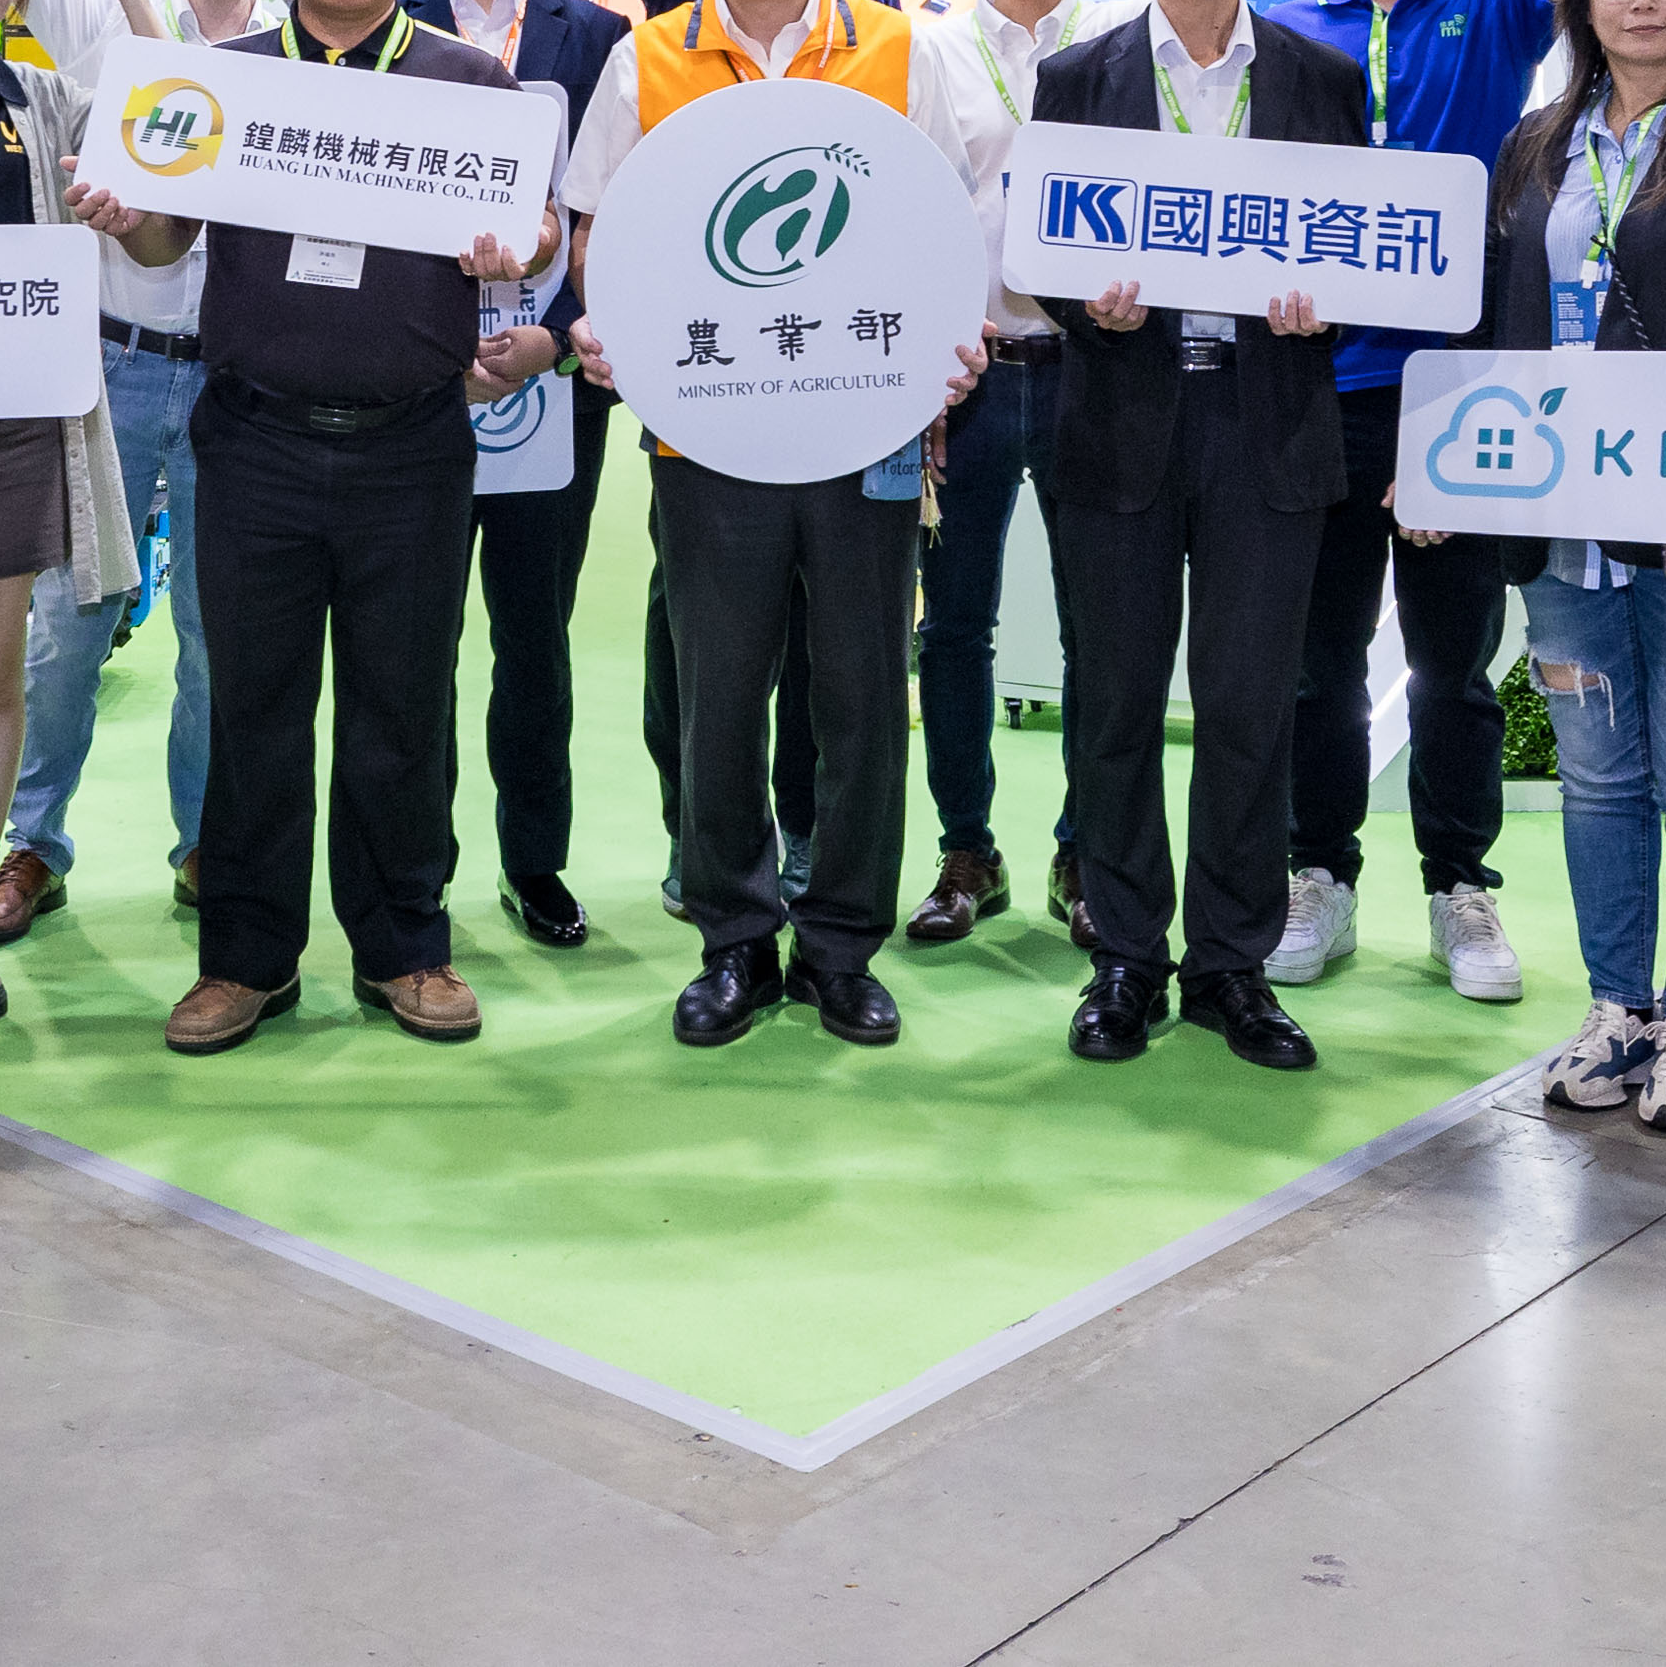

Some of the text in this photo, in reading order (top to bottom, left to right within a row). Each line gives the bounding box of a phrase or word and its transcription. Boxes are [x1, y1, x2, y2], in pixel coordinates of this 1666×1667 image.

[239, 153, 515, 205] HUANG LIN MACHINERY CO., LTD.
[242, 121, 519, 187] 鍠麟機械有限公司
[1140, 184, 1449, 277] 國興資訊
[676, 309, 903, 367] 農業部
[677, 372, 906, 400] MINISTRY OF AGRICULTURE
